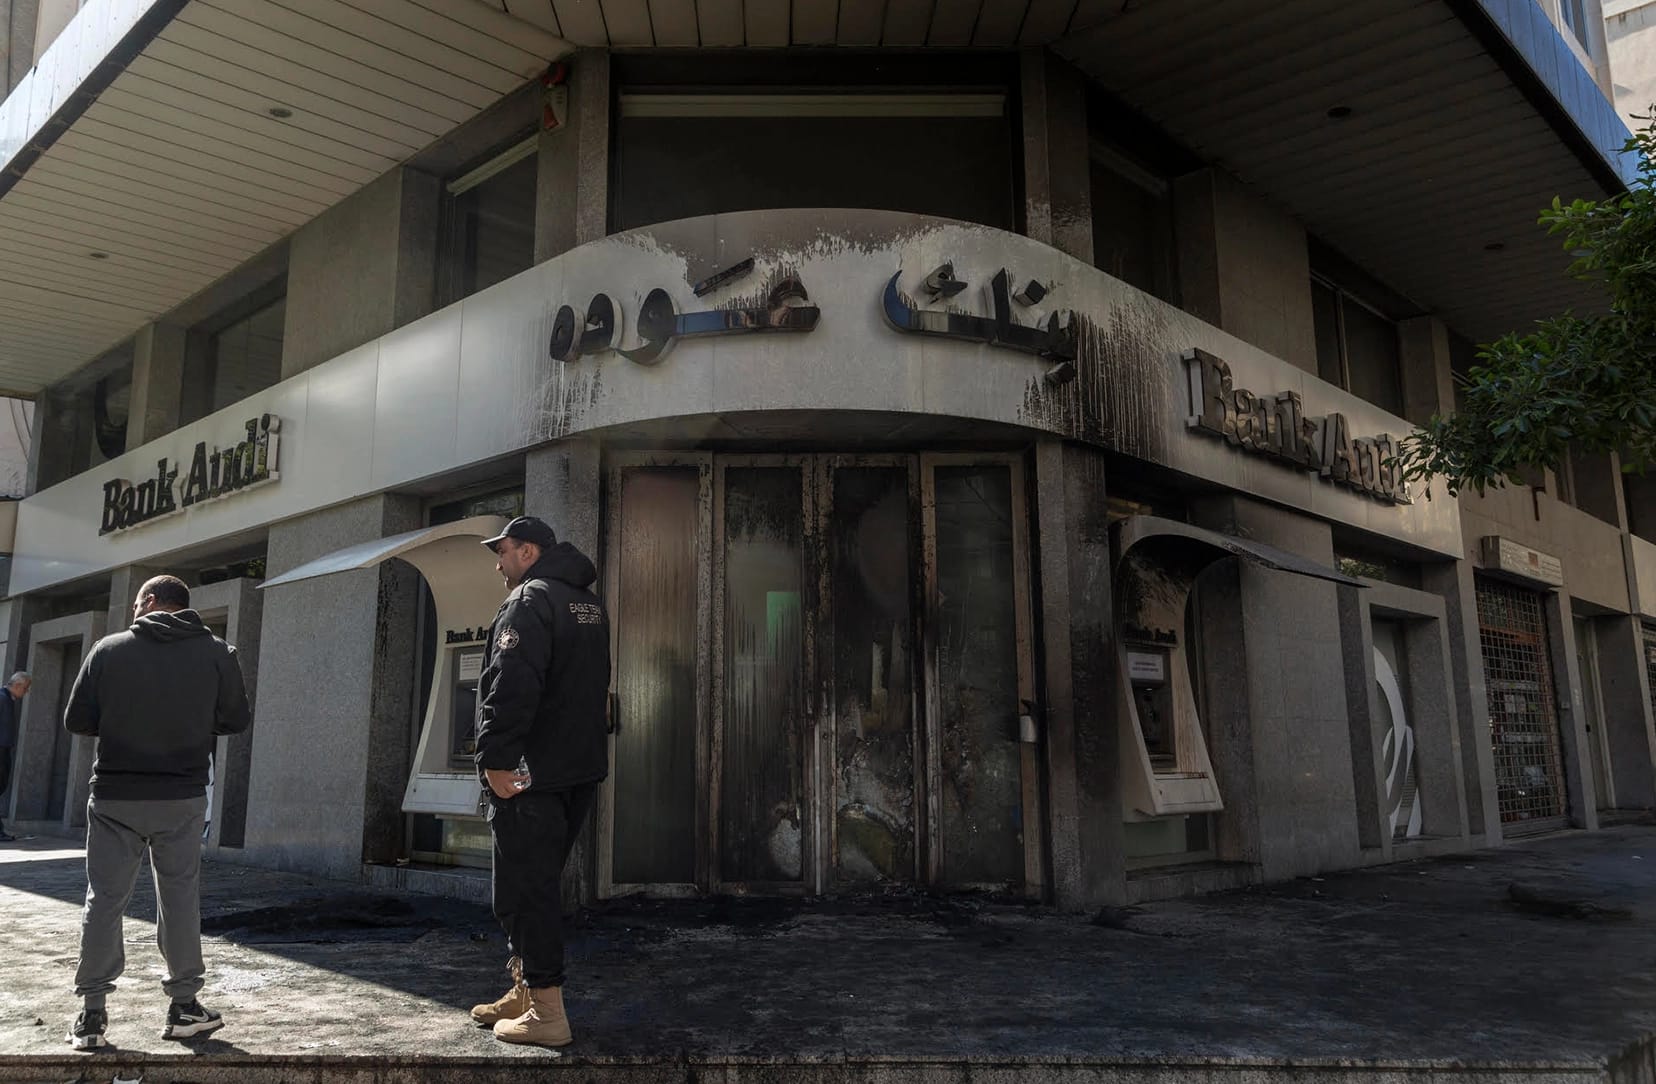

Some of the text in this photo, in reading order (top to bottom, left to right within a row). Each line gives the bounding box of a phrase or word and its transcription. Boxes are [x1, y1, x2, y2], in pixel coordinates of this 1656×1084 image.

[884, 260, 1077, 384] بنك
[1184, 347, 1324, 473] Bank
[99, 413, 281, 519] Bank Audi
[446, 628, 474, 643] Bank
[569, 603, 589, 613] EAGLE
